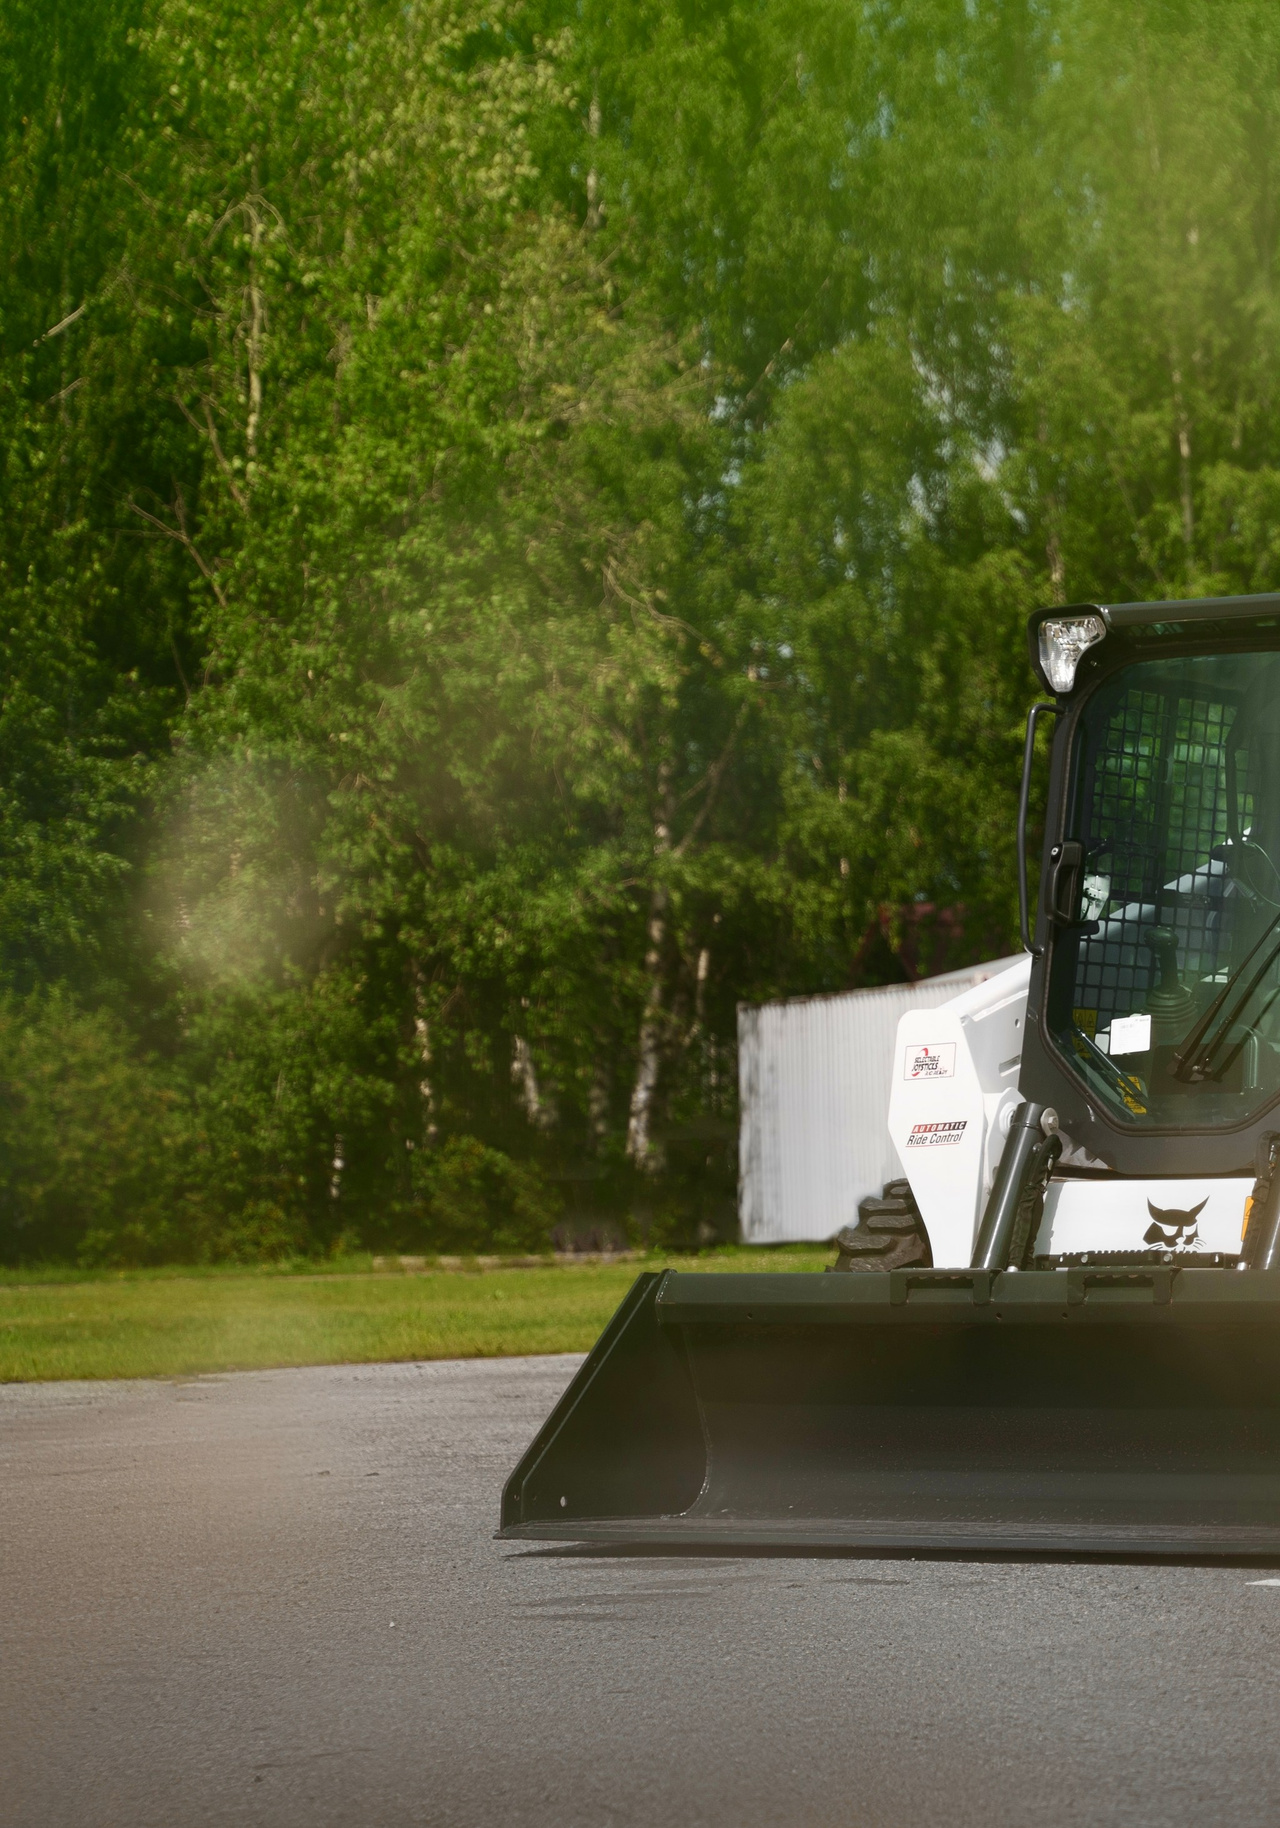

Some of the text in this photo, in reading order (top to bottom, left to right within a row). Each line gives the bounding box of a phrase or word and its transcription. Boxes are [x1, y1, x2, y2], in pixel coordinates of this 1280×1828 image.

[911, 1062, 939, 1072] JOYSTICKS
[912, 1121, 966, 1133] AUTOMATIC
[906, 1131, 964, 1145] Ride Control
